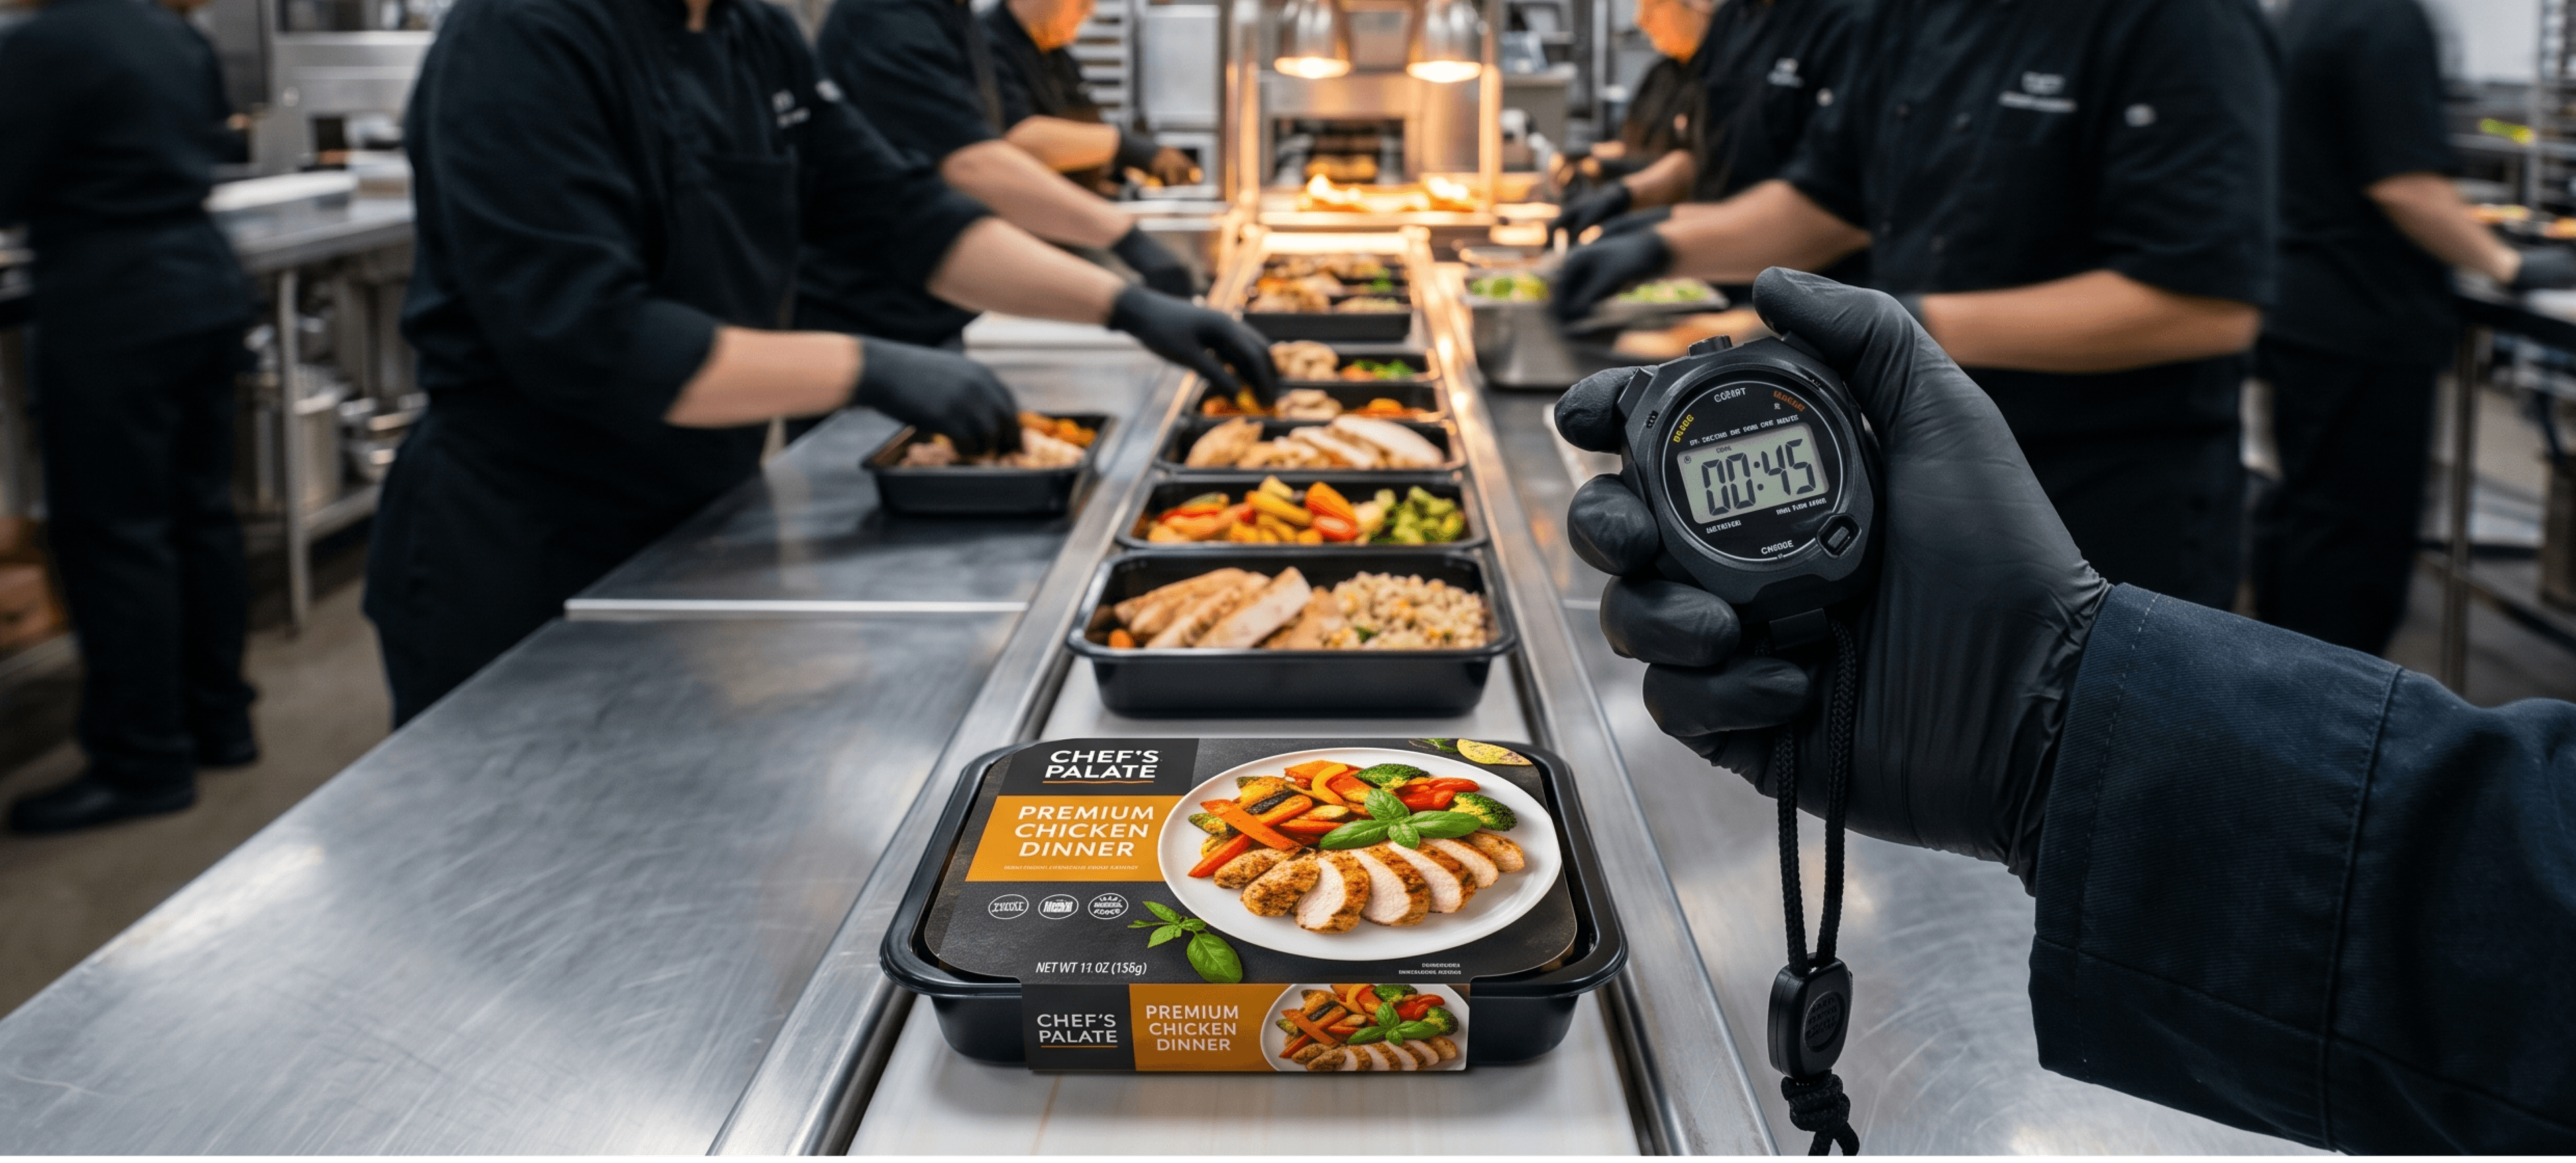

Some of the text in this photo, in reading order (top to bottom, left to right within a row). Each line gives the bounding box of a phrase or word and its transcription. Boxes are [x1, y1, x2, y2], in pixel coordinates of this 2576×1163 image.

[1701, 439, 1817, 516] 00:45
[1051, 750, 1159, 763] CHEF'S
[1044, 765, 1157, 778] PALATE
[1018, 806, 1154, 820] PREMIUM
[1014, 824, 1148, 838] CHICKEN
[1019, 842, 1134, 856] DINNER
[1036, 962, 1058, 973] NET
[1060, 962, 1078, 973] WT
[1095, 962, 1110, 973] OZ
[1146, 1005, 1238, 1019] PREMIUM
[1036, 1013, 1116, 1028] CHEF'S
[1148, 1023, 1237, 1036] CHICKEN
[1039, 1030, 1118, 1043] PALATE
[1157, 1039, 1230, 1051] DINNER
